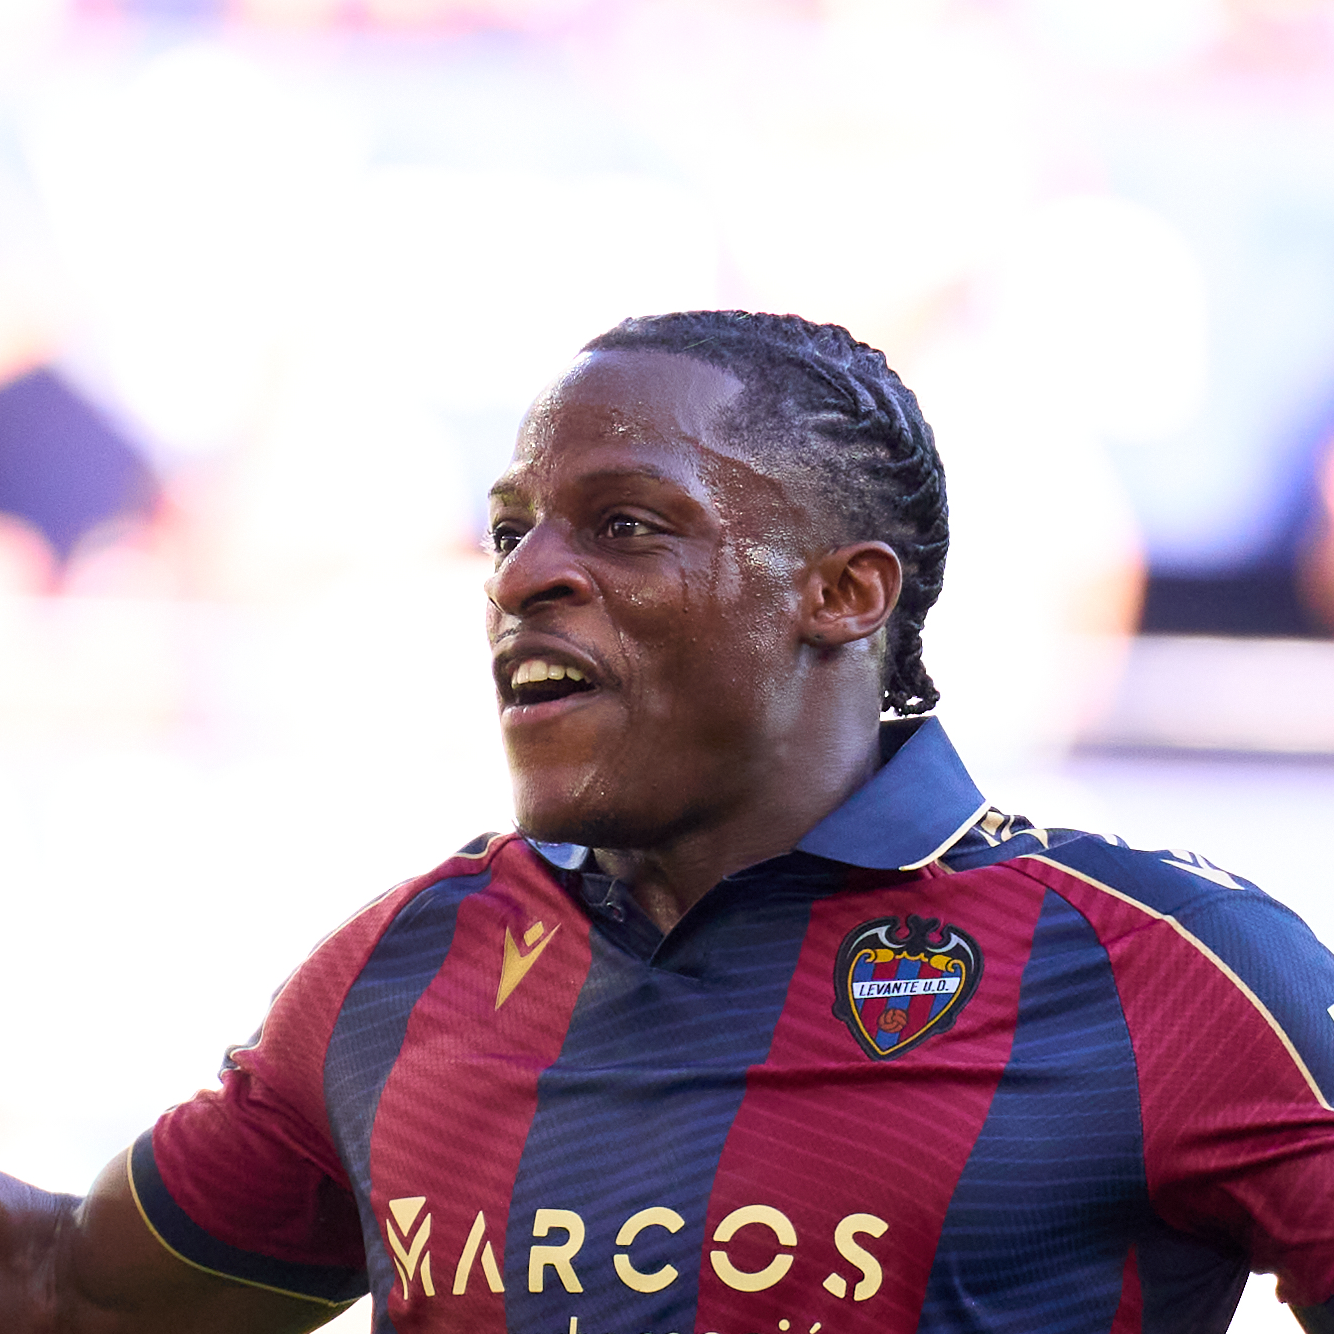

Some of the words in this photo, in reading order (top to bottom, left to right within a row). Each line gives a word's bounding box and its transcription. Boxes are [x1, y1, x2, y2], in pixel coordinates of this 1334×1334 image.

[859, 981, 919, 996] LEVANTE
[922, 979, 949, 993] U.D.
[385, 1196, 890, 1302] MARCOS
